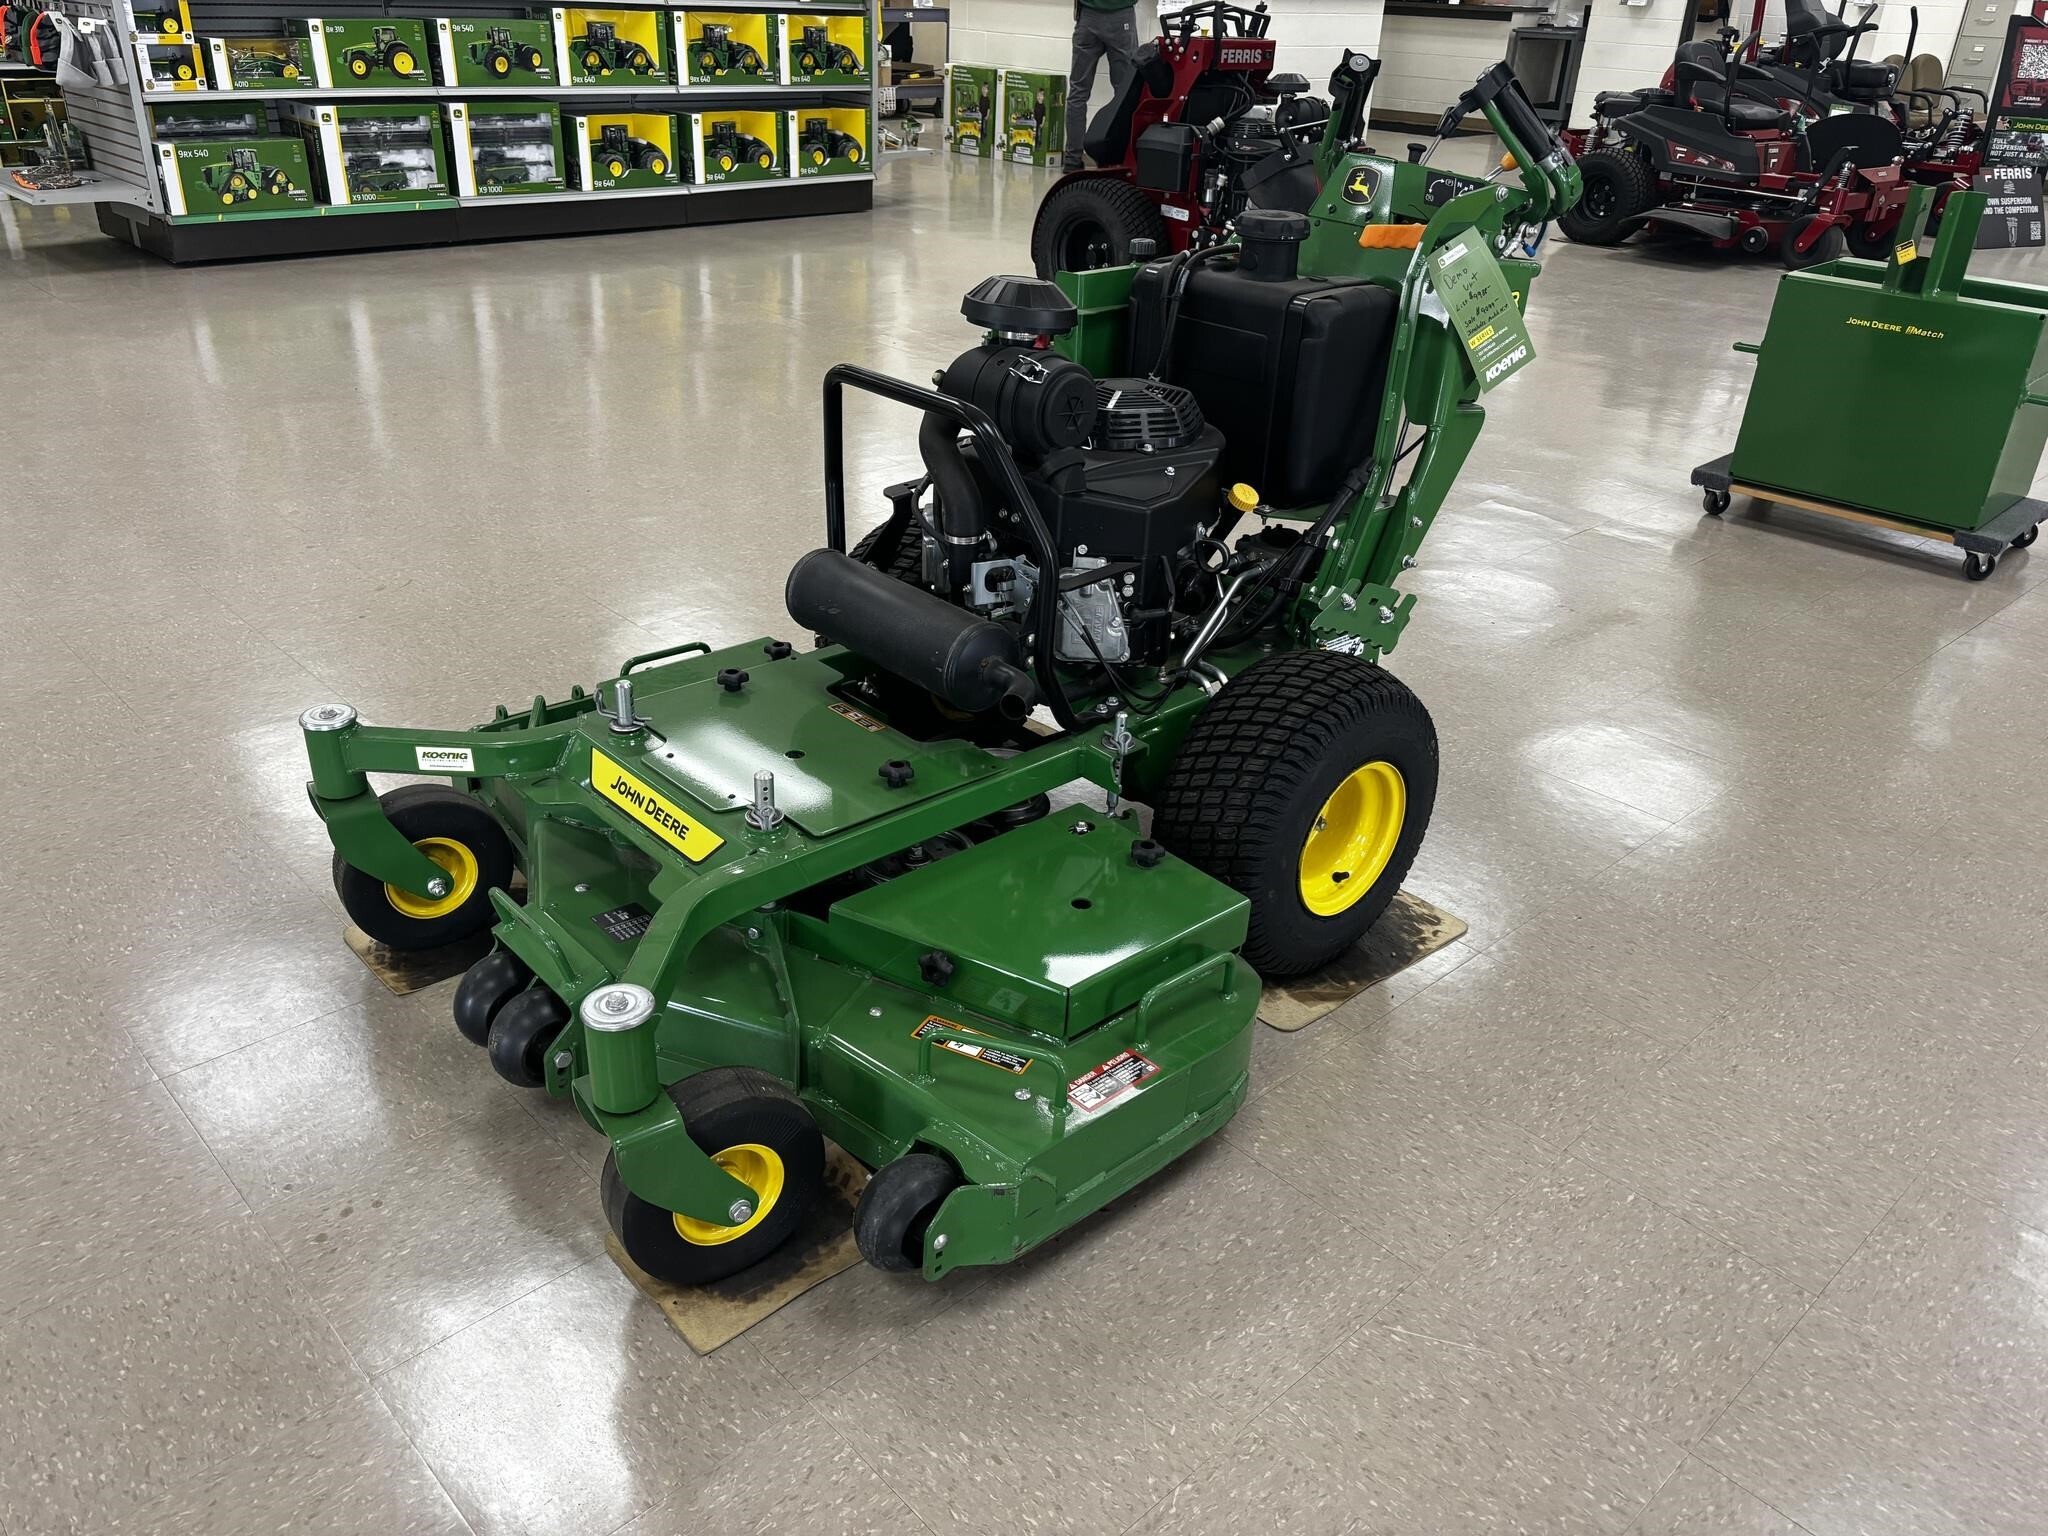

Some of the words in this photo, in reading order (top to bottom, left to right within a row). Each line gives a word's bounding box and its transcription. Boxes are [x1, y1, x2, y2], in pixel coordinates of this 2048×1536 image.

[335, 25, 345, 33] 310
[452, 24, 461, 32] 9R
[461, 24, 475, 32] 540
[1220, 48, 1262, 63] FERRIS
[584, 75, 596, 83] 640
[700, 75, 711, 83] 640
[800, 75, 811, 83] 640
[234, 80, 249, 88] 4010
[2013, 121, 2035, 130] JOHN
[178, 150, 193, 158] 9RX
[193, 149, 209, 158] 540
[1993, 167, 2033, 180] FERRIS
[594, 180, 603, 188] 9R
[361, 193, 376, 201] 1000
[2000, 196, 2032, 205] SUSPENSION
[1994, 206, 2004, 215] THE
[2004, 205, 2039, 214] COMPETITION
[1443, 268, 1468, 290] Demo
[1846, 317, 1871, 327] JOHN
[1871, 321, 1902, 332] DEERE
[1476, 328, 1493, 343] SERIES
[610, 776, 646, 809] JOHN
[644, 797, 690, 841] DEERE
[1074, 1071, 1097, 1085] DANGER
